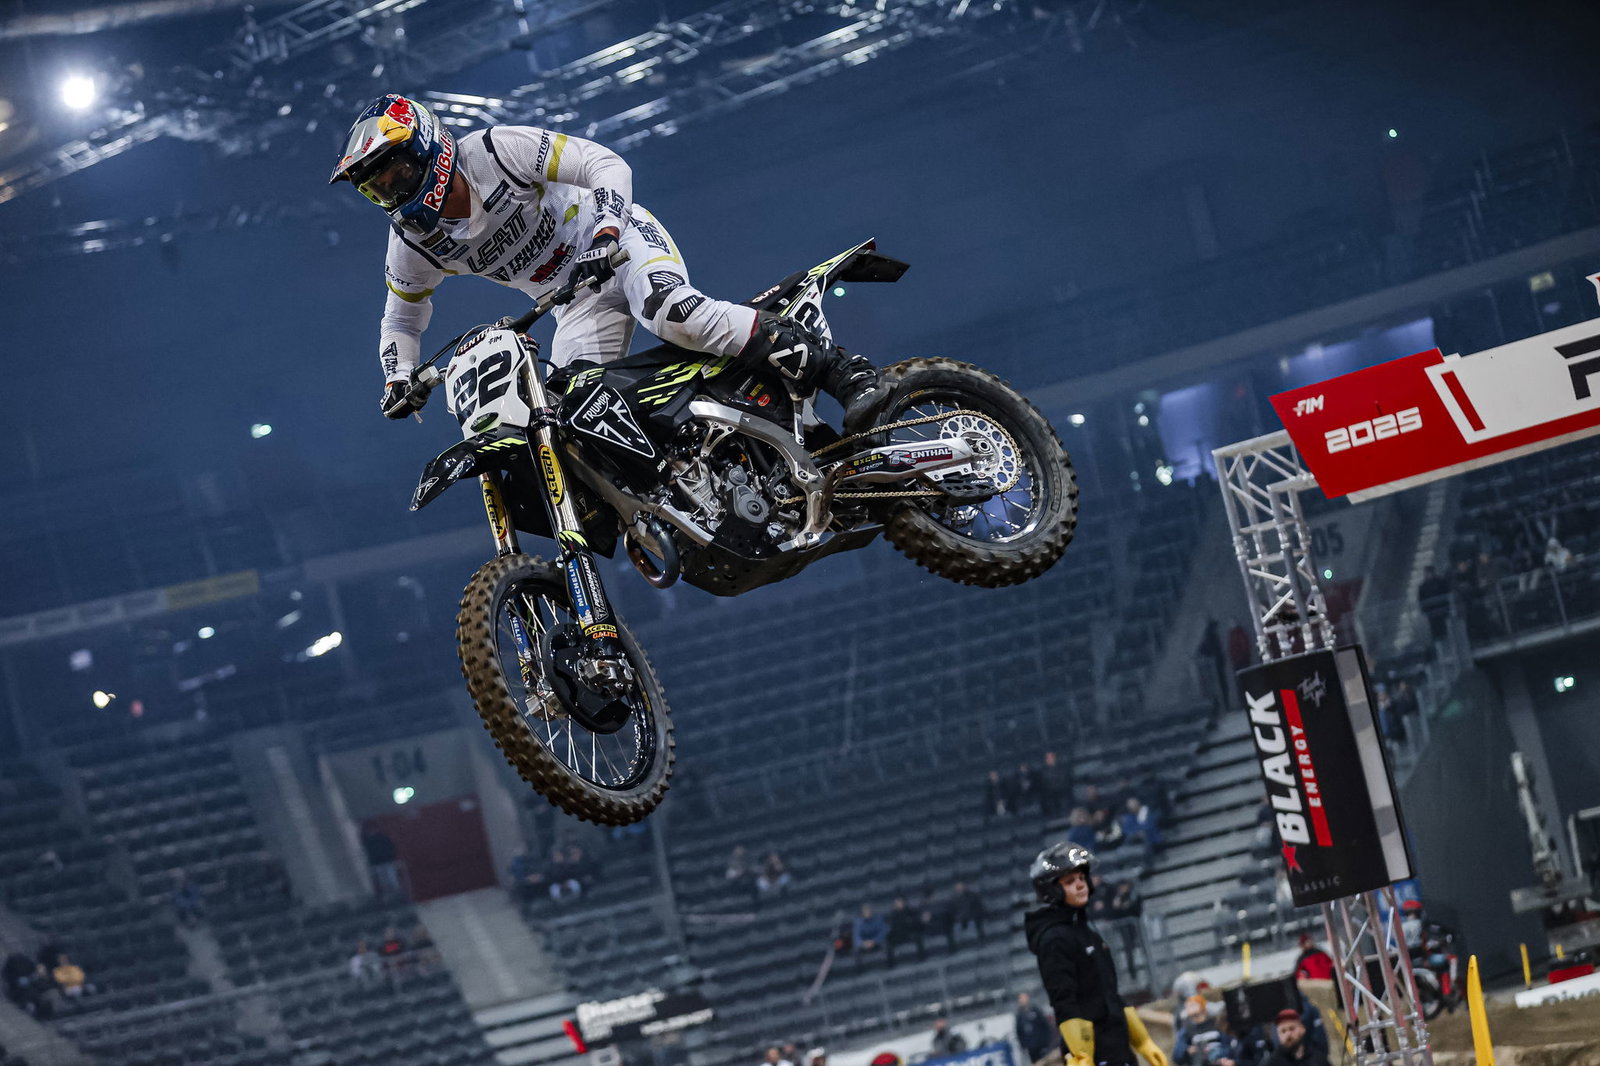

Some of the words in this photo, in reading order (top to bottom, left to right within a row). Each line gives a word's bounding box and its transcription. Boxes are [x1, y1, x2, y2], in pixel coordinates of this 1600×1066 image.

[423, 165, 450, 212] Red
[437, 127, 453, 173] Bull
[467, 203, 528, 273] LEATT
[506, 206, 550, 270] TRIUMPH
[511, 217, 557, 276] RACING
[453, 350, 512, 430] 22
[582, 391, 611, 422] TRIUMPH
[1293, 394, 1324, 416] FIM
[1325, 407, 1423, 454] 2025
[541, 448, 560, 499] K-tech
[853, 454, 884, 467] EXCEL
[566, 561, 584, 607] MICHELIN
[583, 555, 601, 608] PERFORMANCE
[1245, 690, 1310, 845] BLACK
[1291, 725, 1322, 808] ENERGY
